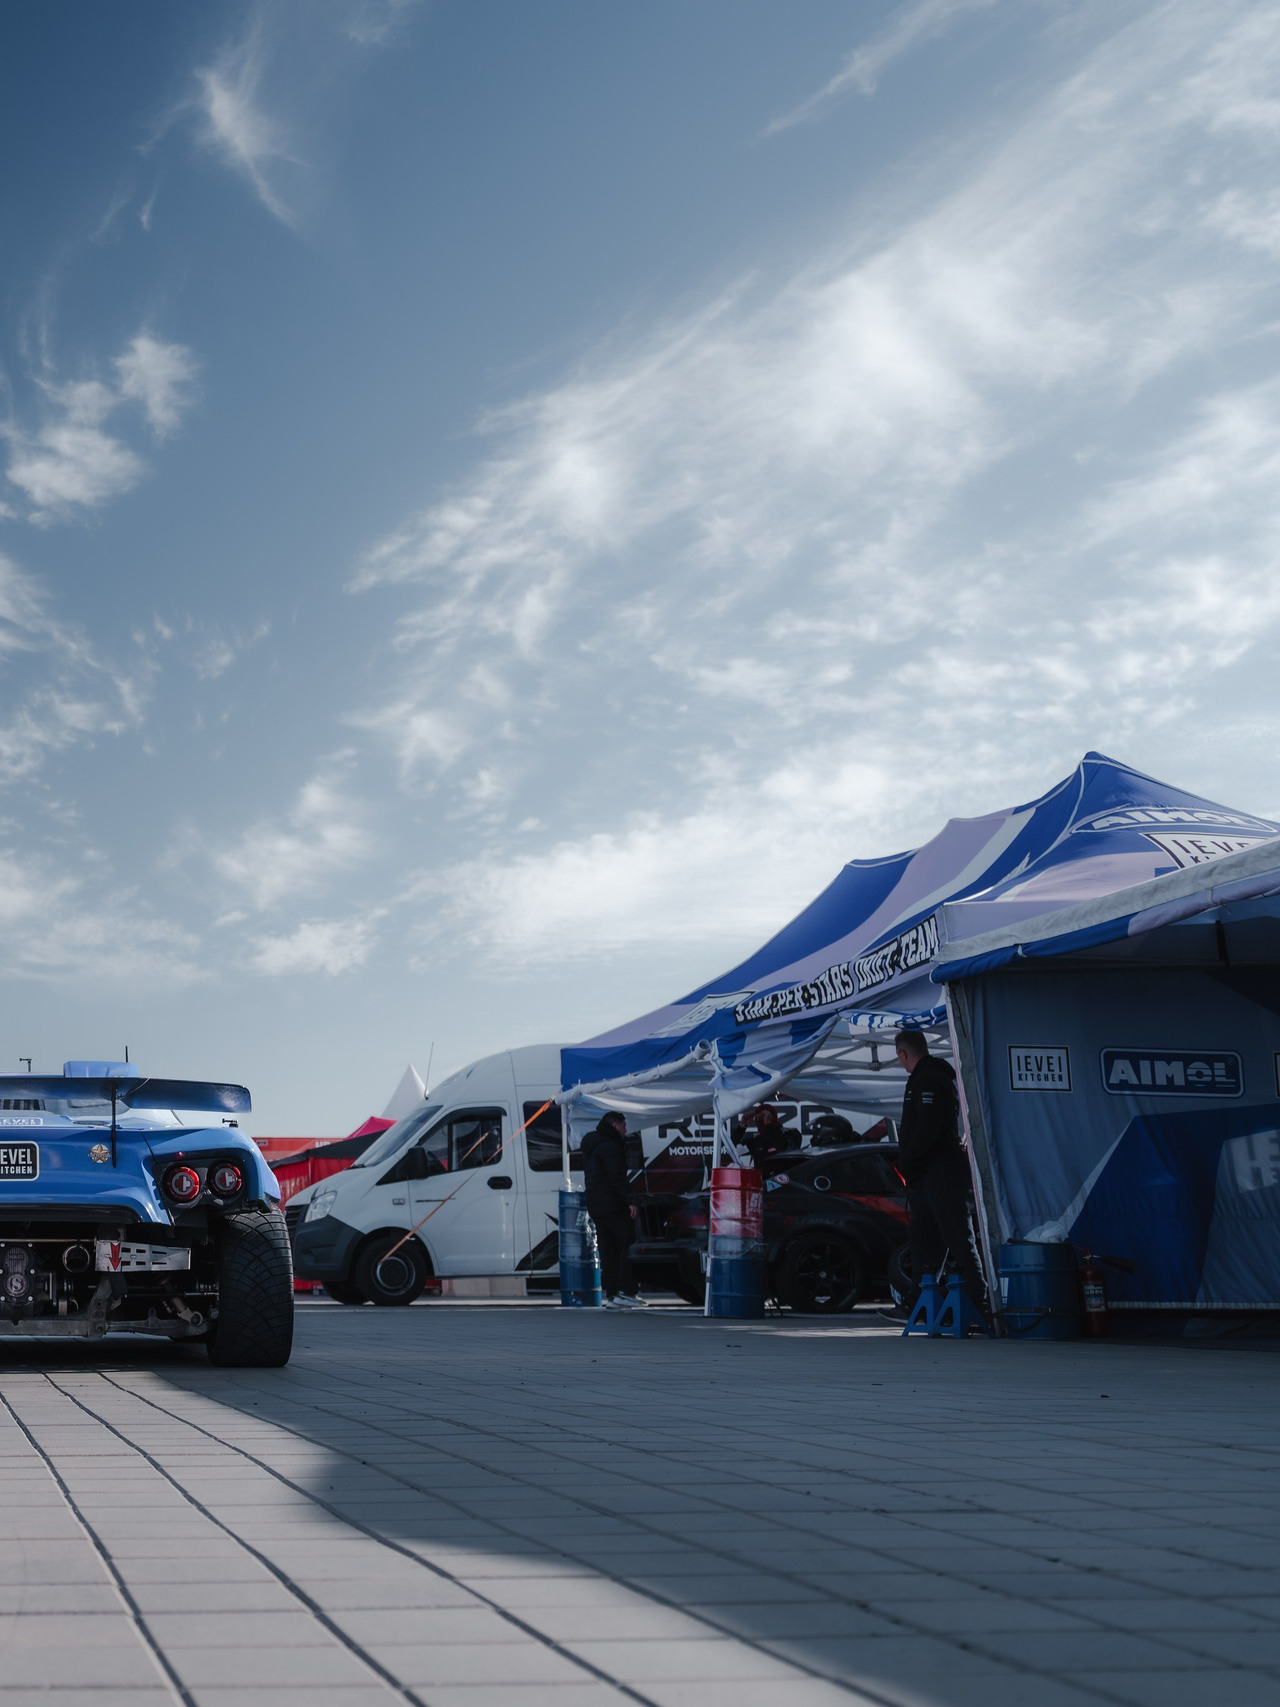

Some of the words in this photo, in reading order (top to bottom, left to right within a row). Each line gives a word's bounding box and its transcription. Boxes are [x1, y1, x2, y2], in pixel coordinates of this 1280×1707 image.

[807, 962, 854, 1007] STARS
[854, 941, 898, 990] DRIFT
[899, 917, 939, 970] TEAM
[1018, 1073, 1063, 1082] KITCHEN
[1109, 1059, 1236, 1087] AIMOL
